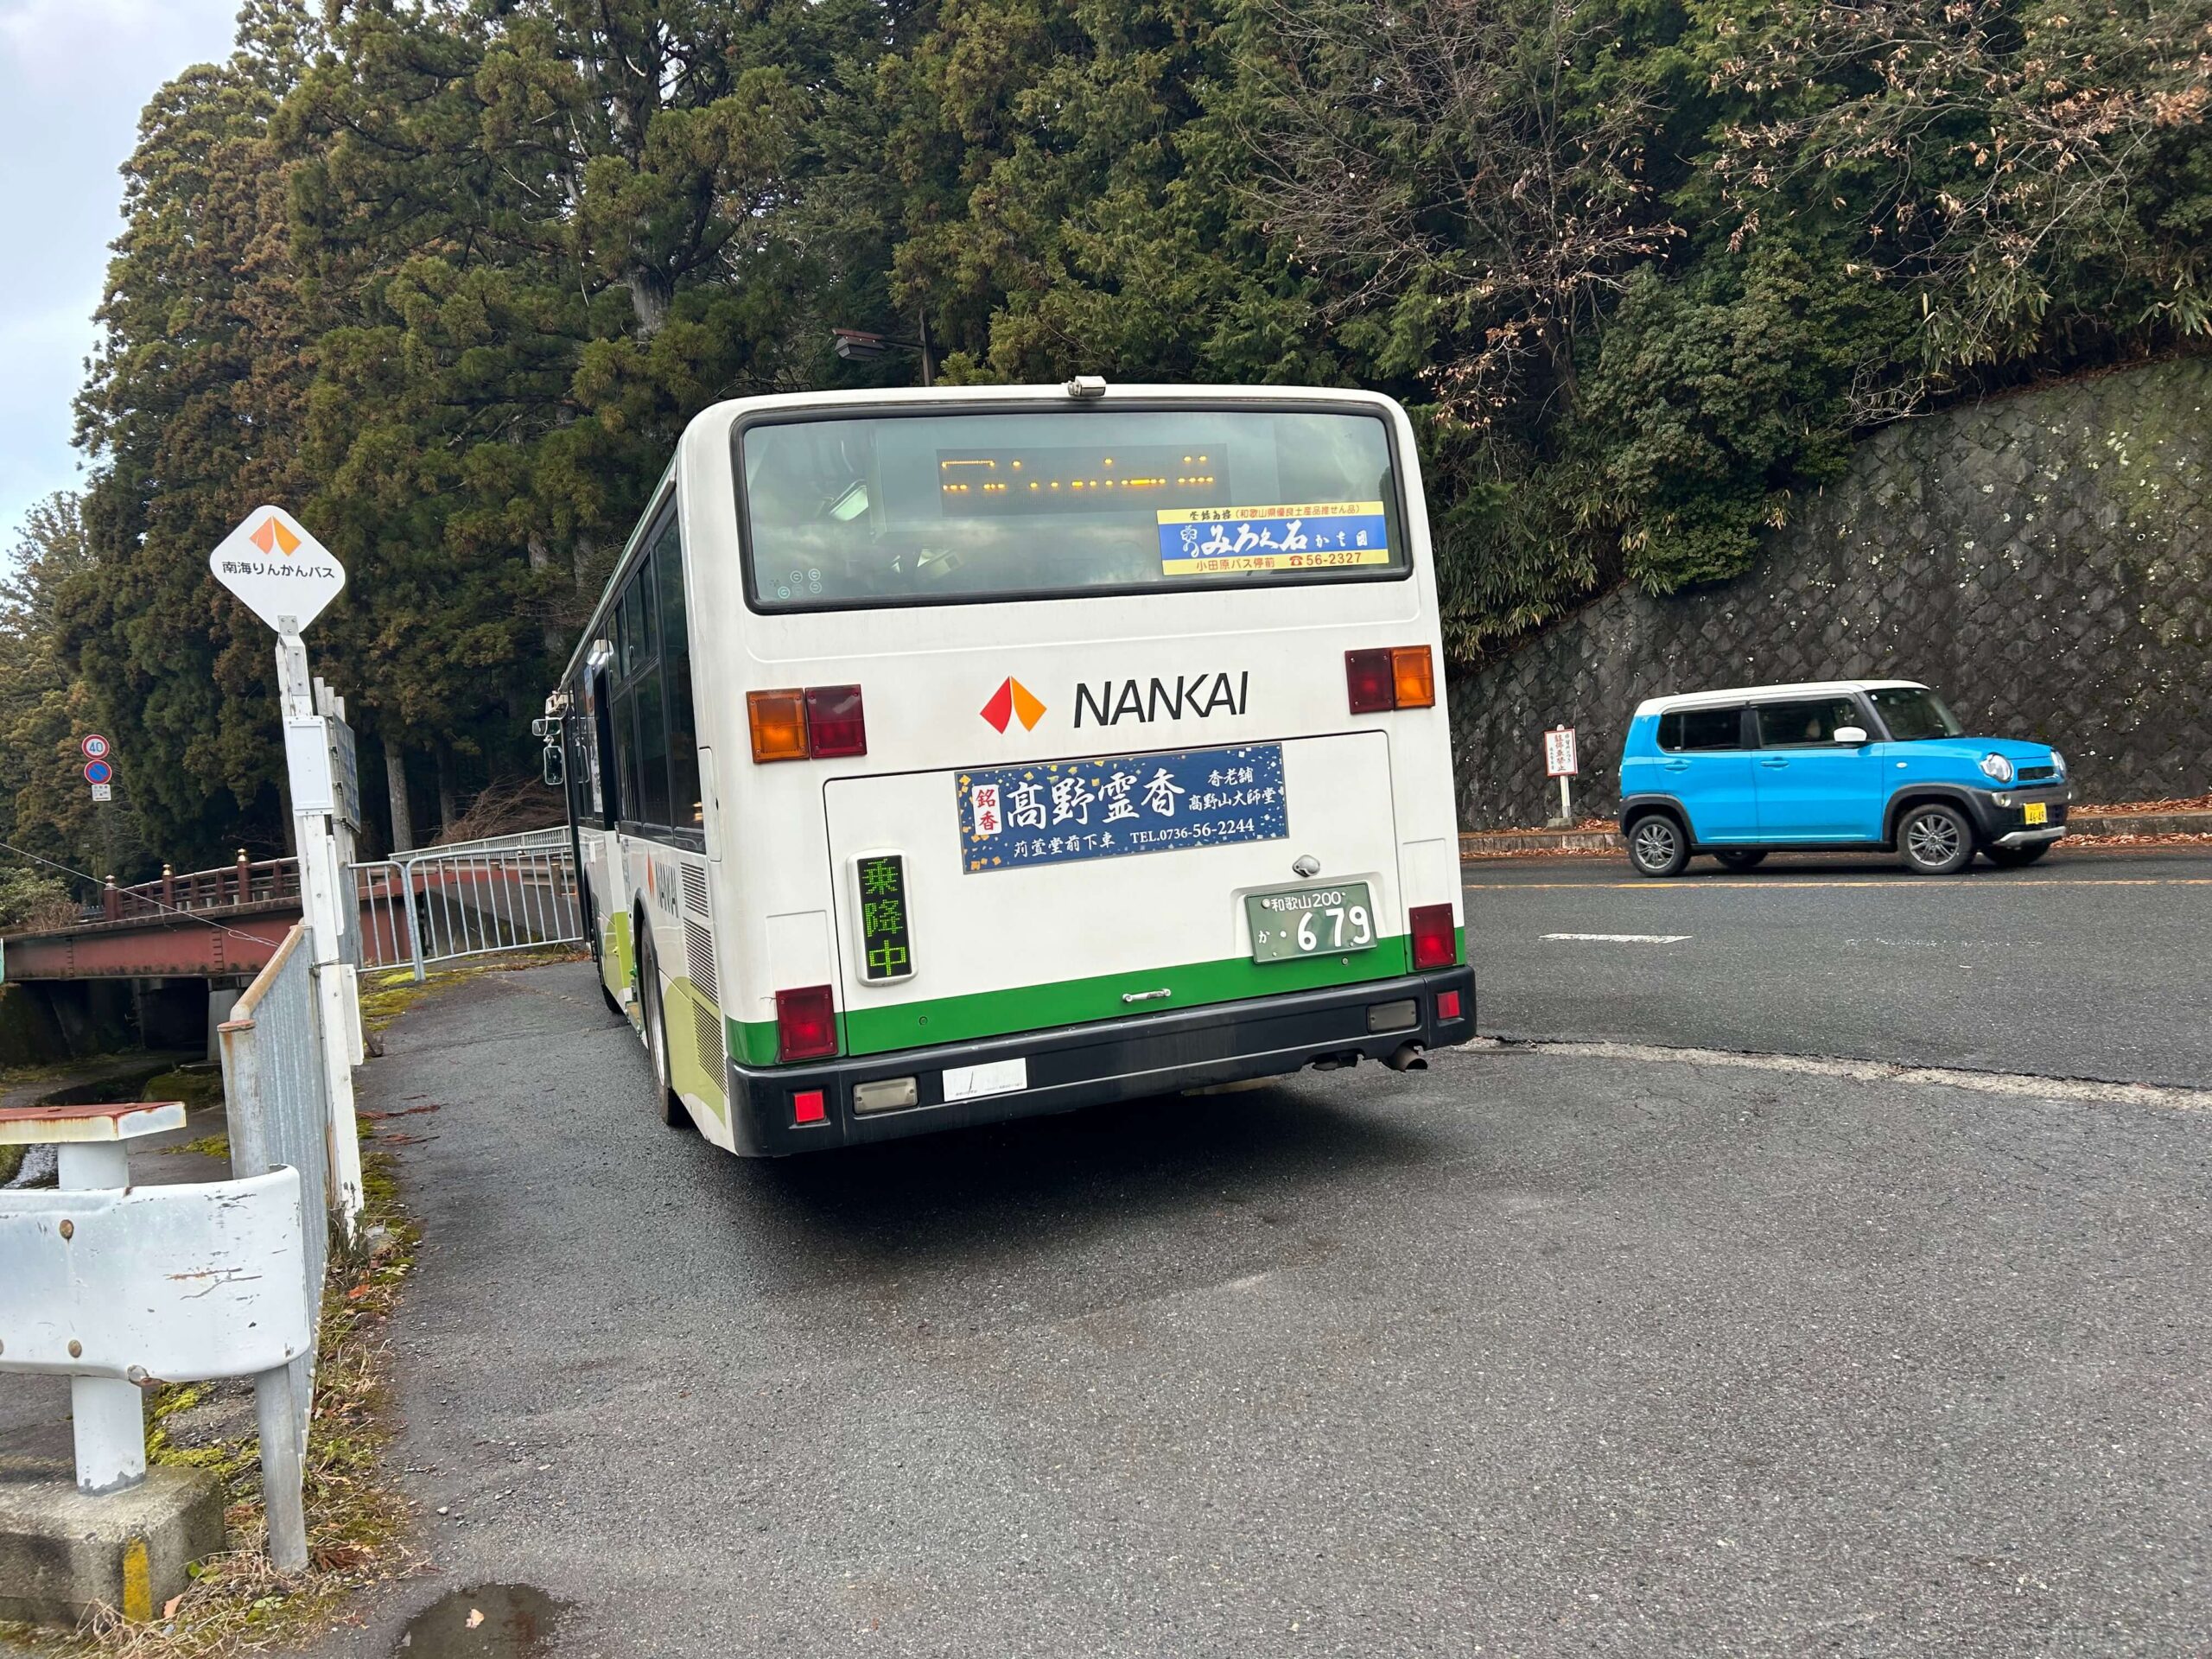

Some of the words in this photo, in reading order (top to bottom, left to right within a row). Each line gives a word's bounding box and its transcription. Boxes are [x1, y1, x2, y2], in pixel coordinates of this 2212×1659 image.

[222, 561, 335, 579] 南海りんかんバス
[1196, 557, 1275, 572] 小田原バス停前
[1306, 551, 1362, 566] 56-2327
[1073, 671, 1249, 728] NANKAI
[89, 741, 103, 753] 40
[1207, 766, 1254, 787] 香老舗
[975, 788, 999, 831] 銘香
[1014, 832, 1116, 858] 苅萱堂前下車
[1129, 817, 1255, 844] TEL.0736-56-2244
[1271, 891, 1342, 912] 和歌山200
[862, 858, 906, 976] 乗降中
